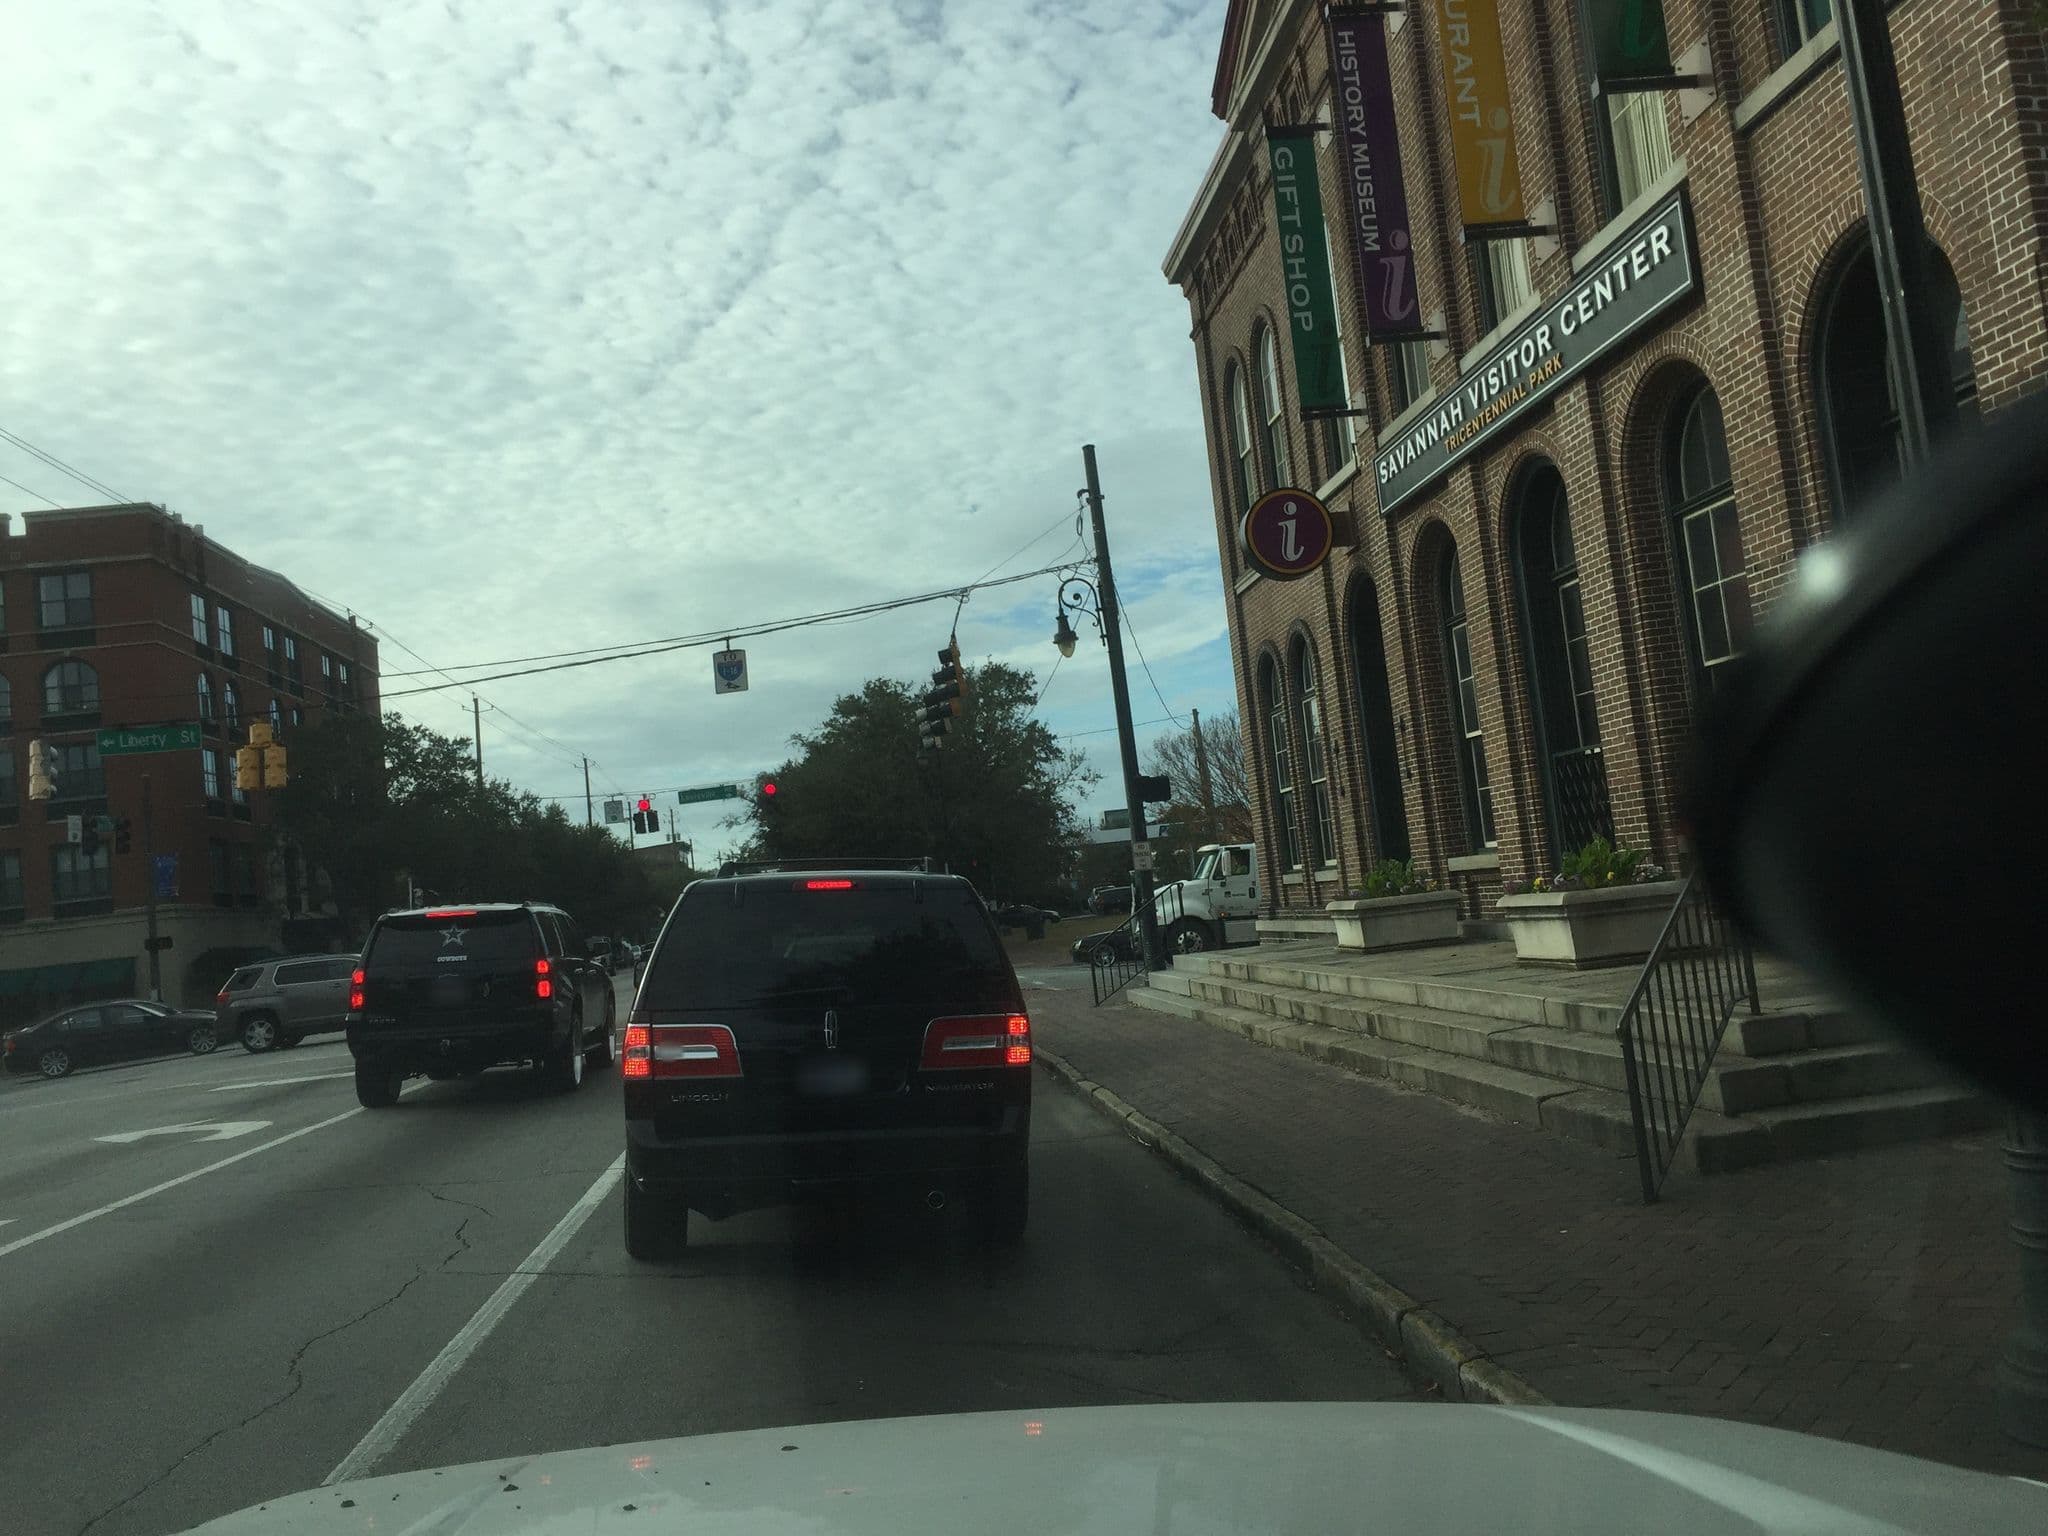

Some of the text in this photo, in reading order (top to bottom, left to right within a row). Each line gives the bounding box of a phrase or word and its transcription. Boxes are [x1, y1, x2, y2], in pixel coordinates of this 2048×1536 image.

[1337, 31, 1381, 252] HISTORY MUSEUM
[1273, 147, 1314, 332] GIFT SHOP
[1378, 224, 1672, 484] SAVANNAH VISITOR CENTER
[1444, 353, 1563, 454] TRICENTENNIAL PARK
[722, 652, 737, 662] TO
[119, 730, 198, 748] Liberty St
